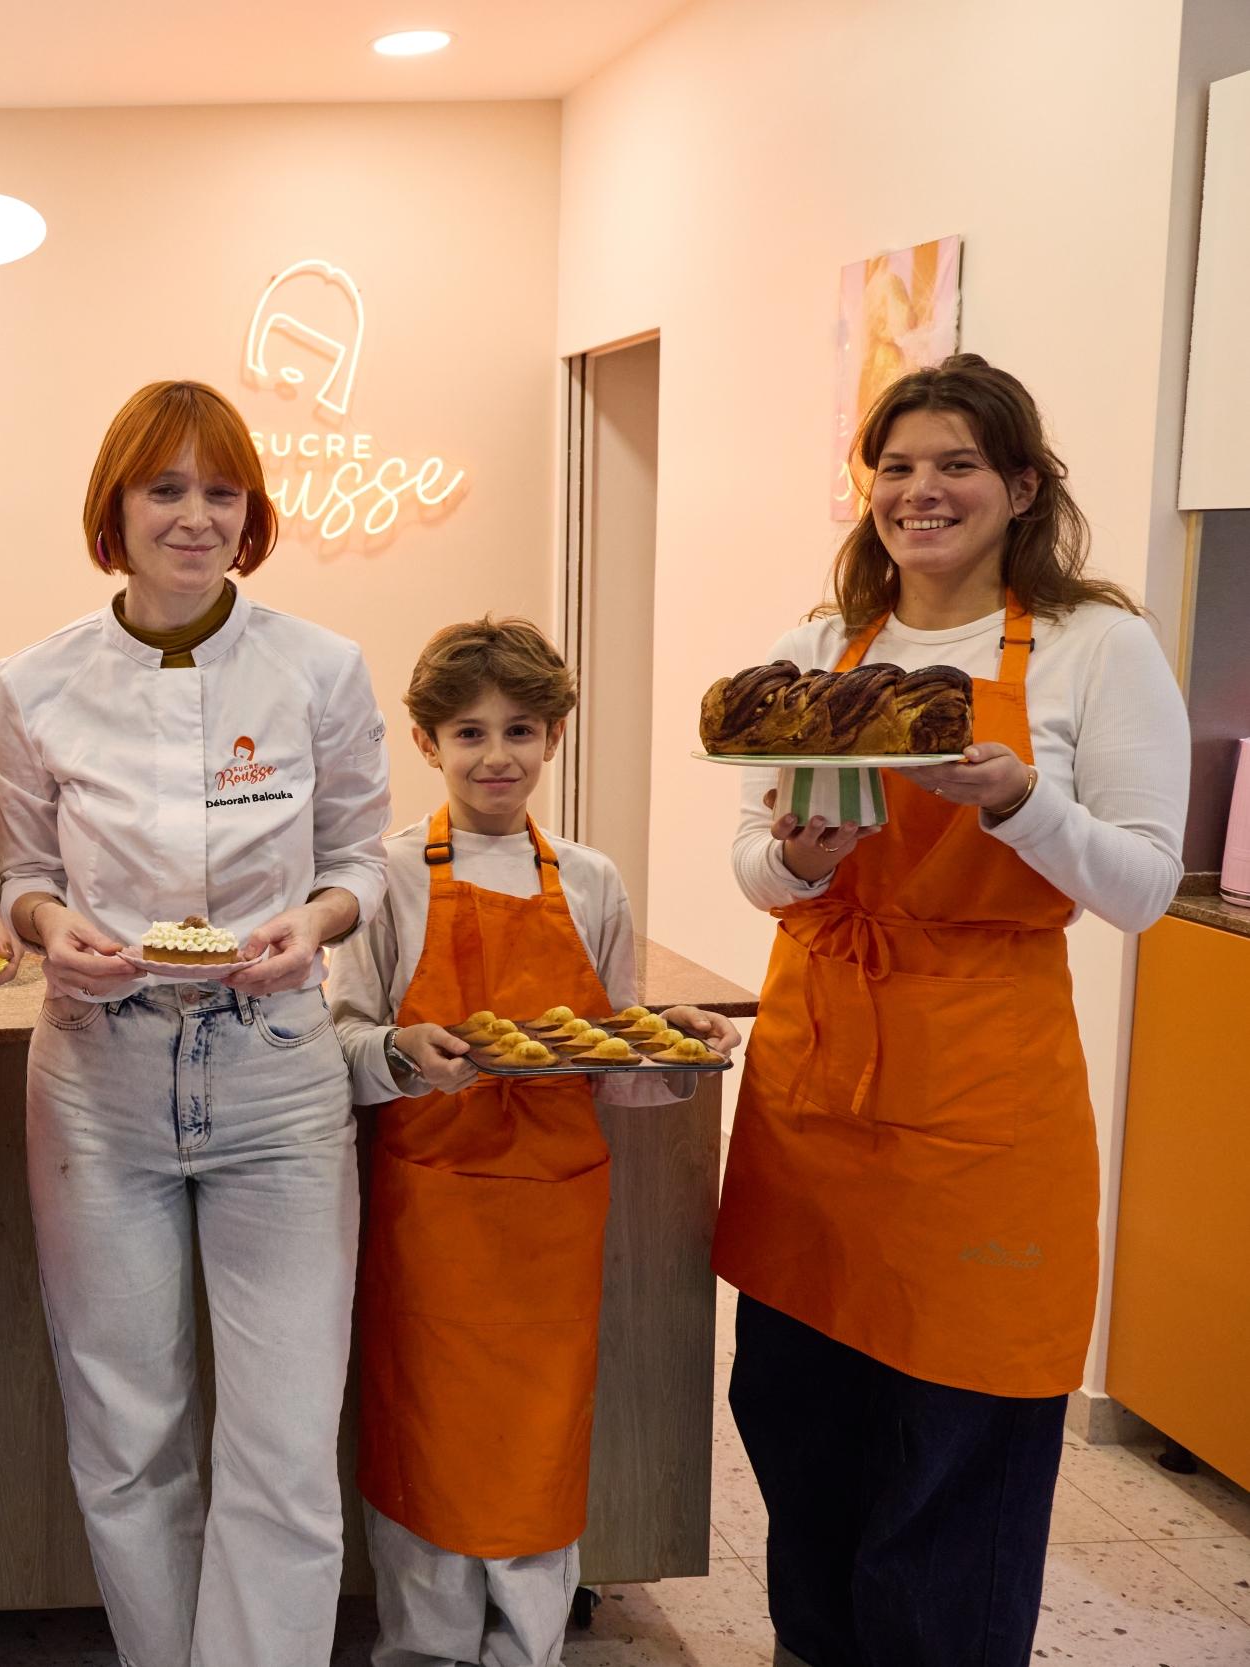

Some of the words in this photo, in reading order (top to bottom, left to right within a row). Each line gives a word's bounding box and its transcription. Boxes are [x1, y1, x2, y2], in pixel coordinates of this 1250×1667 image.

[250, 432, 373, 458] SUCRE
[268, 456, 465, 540] usse
[214, 765, 278, 791] Rousse
[234, 763, 259, 772] SUCRE
[205, 794, 251, 809] Déborah
[251, 790, 294, 803] Balouka
